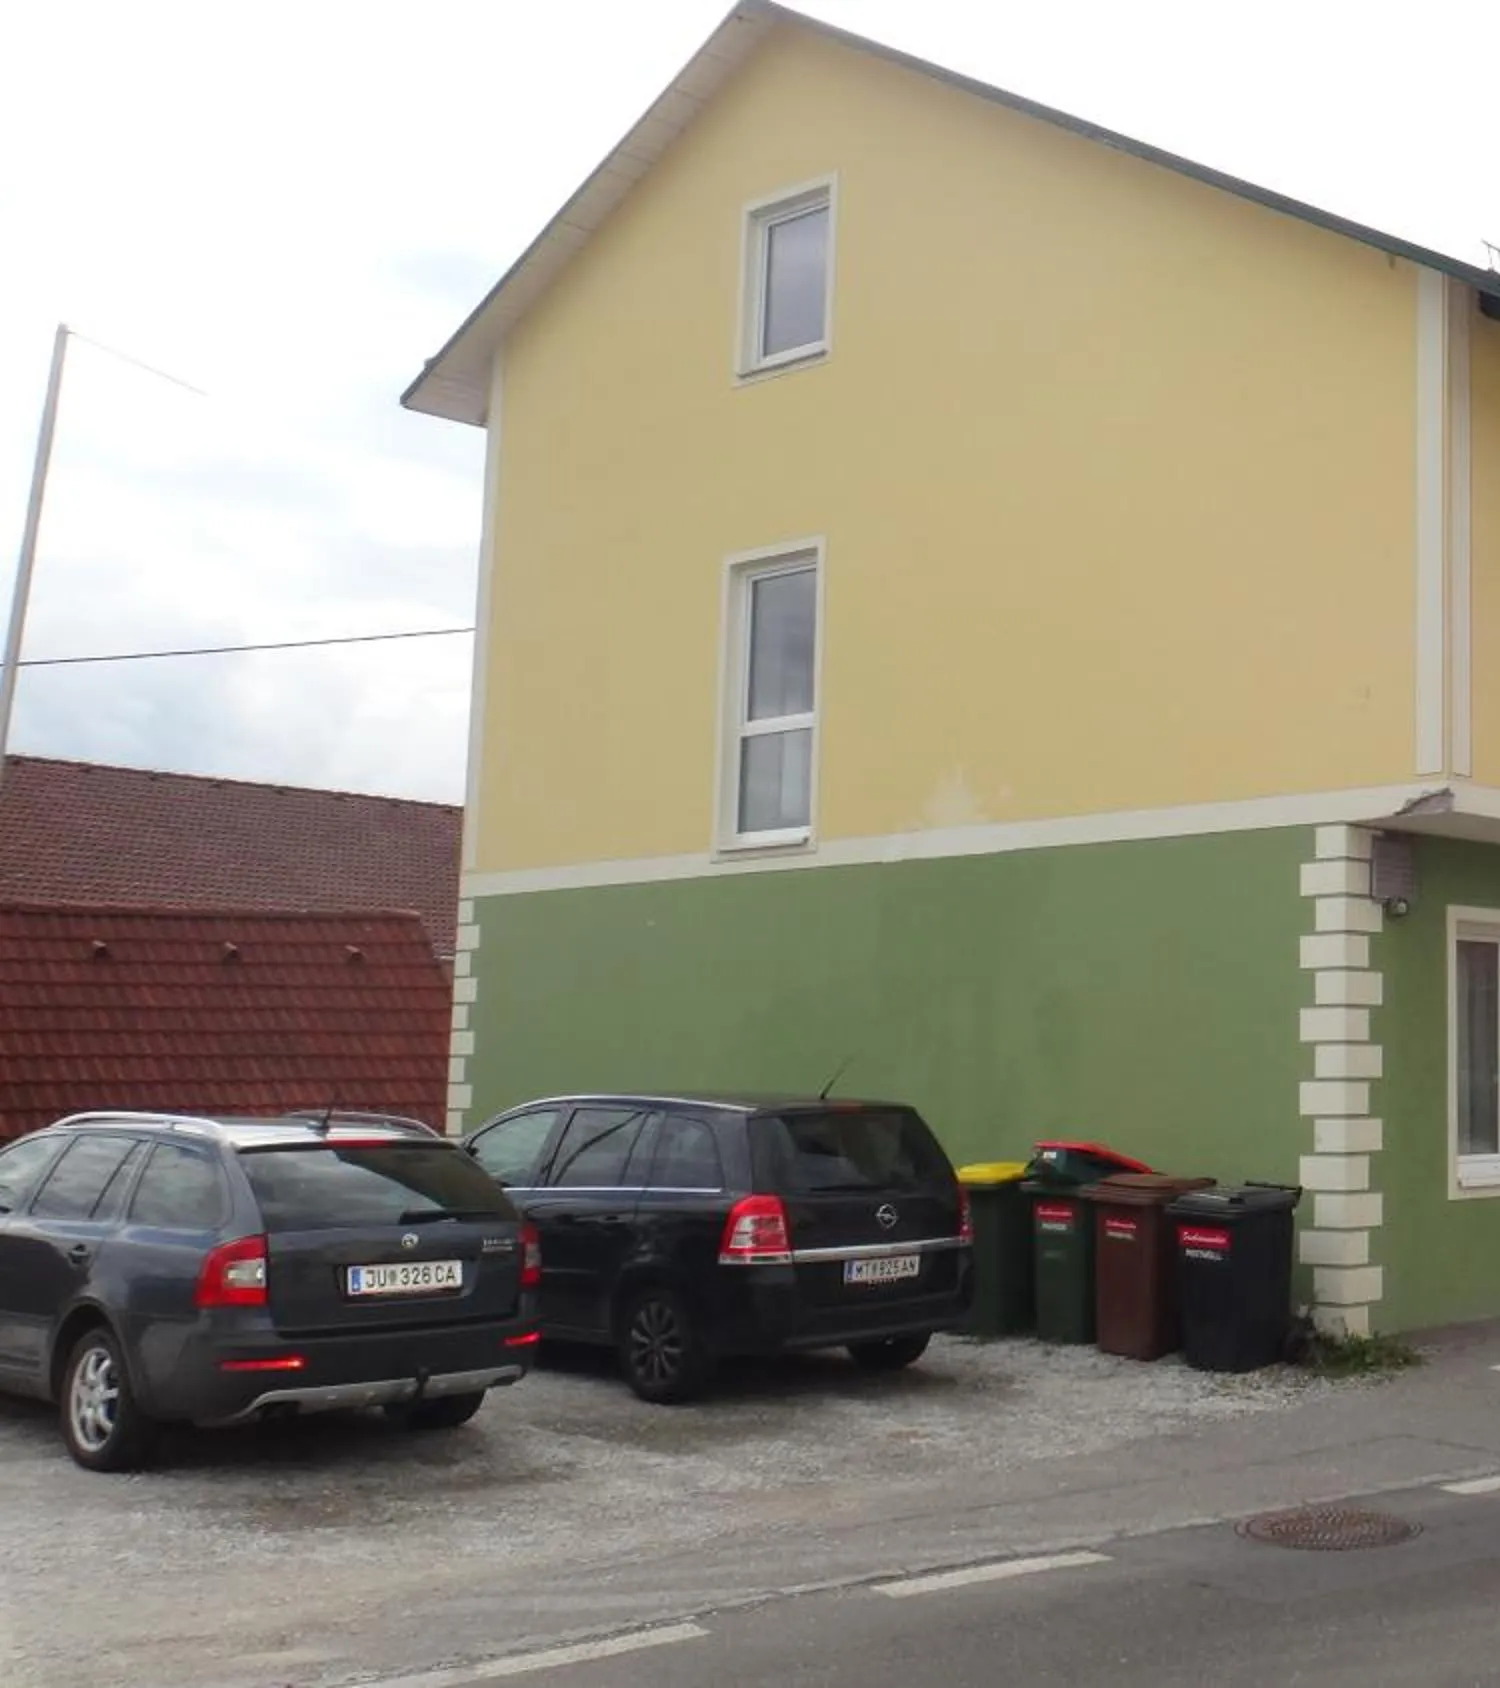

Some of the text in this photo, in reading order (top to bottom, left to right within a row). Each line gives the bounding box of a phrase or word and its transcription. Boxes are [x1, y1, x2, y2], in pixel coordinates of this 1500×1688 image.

[365, 1264, 456, 1288] JU 326 CA
